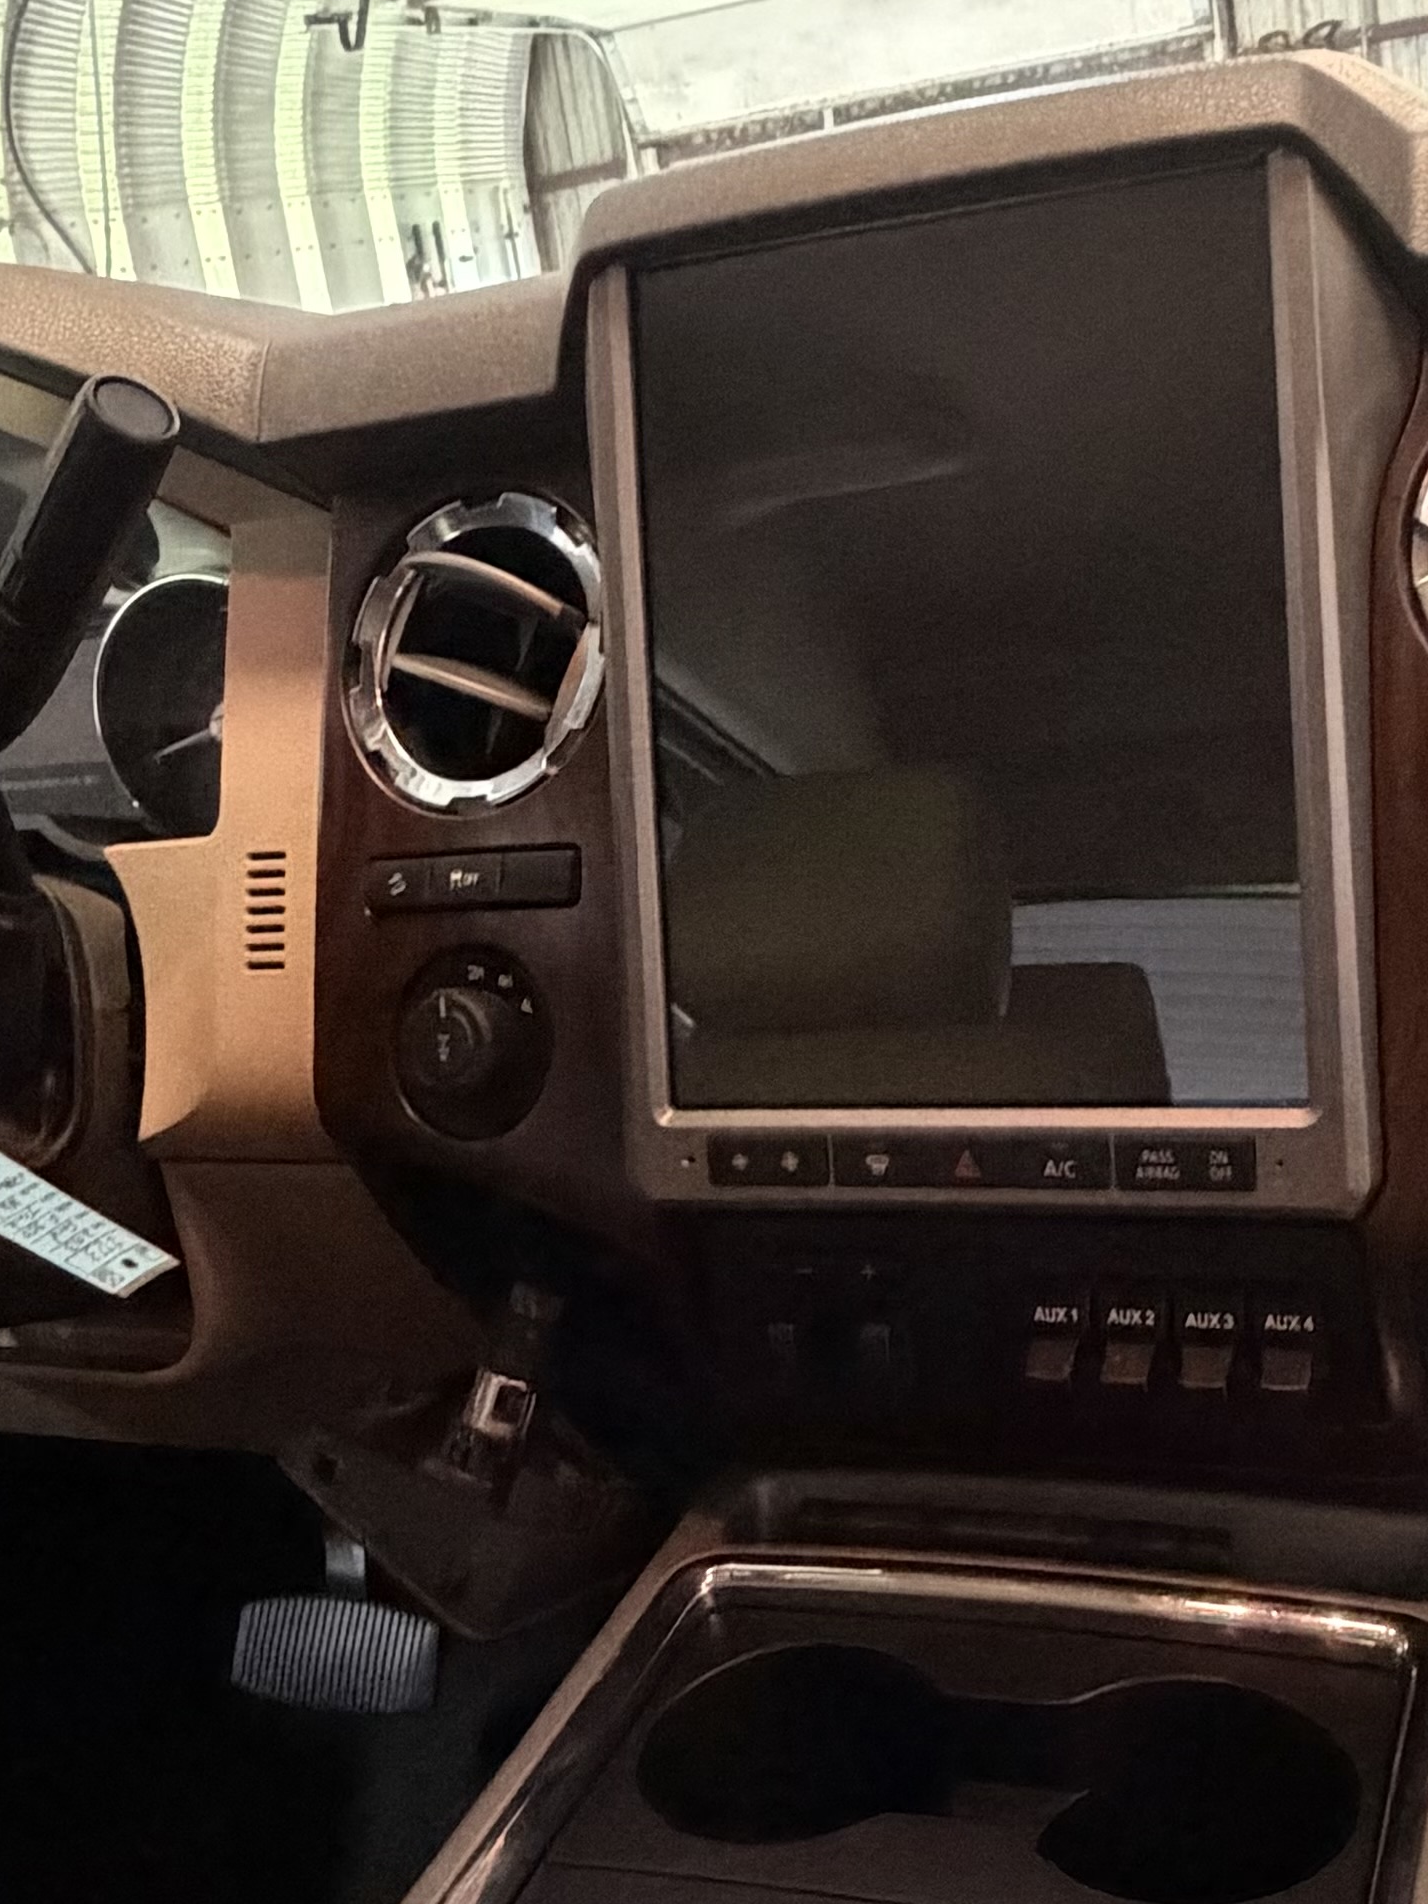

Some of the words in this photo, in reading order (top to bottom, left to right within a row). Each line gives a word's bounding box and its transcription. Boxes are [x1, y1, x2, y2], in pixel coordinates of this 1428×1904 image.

[1141, 1148, 1175, 1163] PASS
[1043, 1159, 1077, 1179] A/C
[1135, 1164, 1181, 1181] AIRBAG
[1033, 1306, 1068, 1323] AUX
[1070, 1307, 1078, 1323] 1
[1106, 1307, 1143, 1327] AUX
[1144, 1309, 1155, 1327] 2
[1184, 1312, 1221, 1330] AUX
[1222, 1313, 1235, 1330] 3
[1263, 1314, 1301, 1332] AUX
[1302, 1315, 1315, 1332] 4
